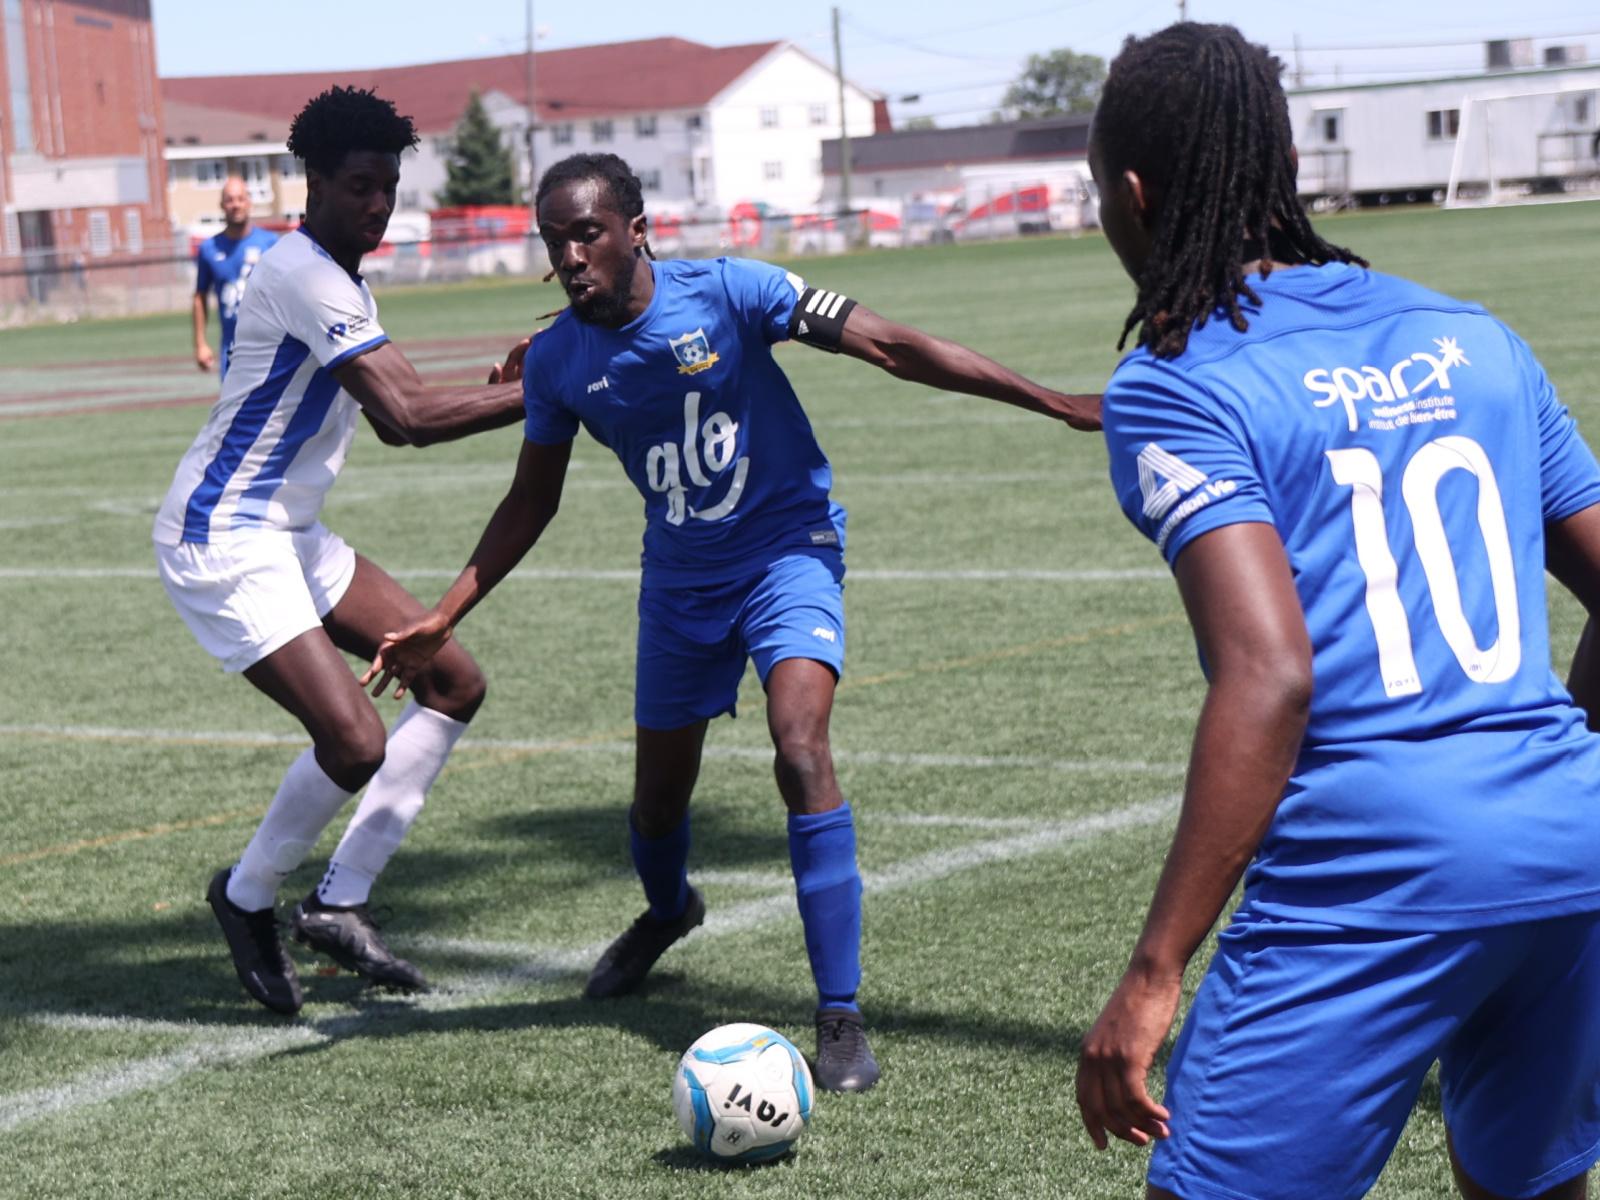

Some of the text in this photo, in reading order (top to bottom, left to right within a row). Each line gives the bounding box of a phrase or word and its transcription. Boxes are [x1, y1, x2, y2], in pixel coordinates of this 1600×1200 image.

[1304, 337, 1468, 432] sparx
[1324, 435, 1521, 698] 10
[723, 1083, 789, 1127] savi
